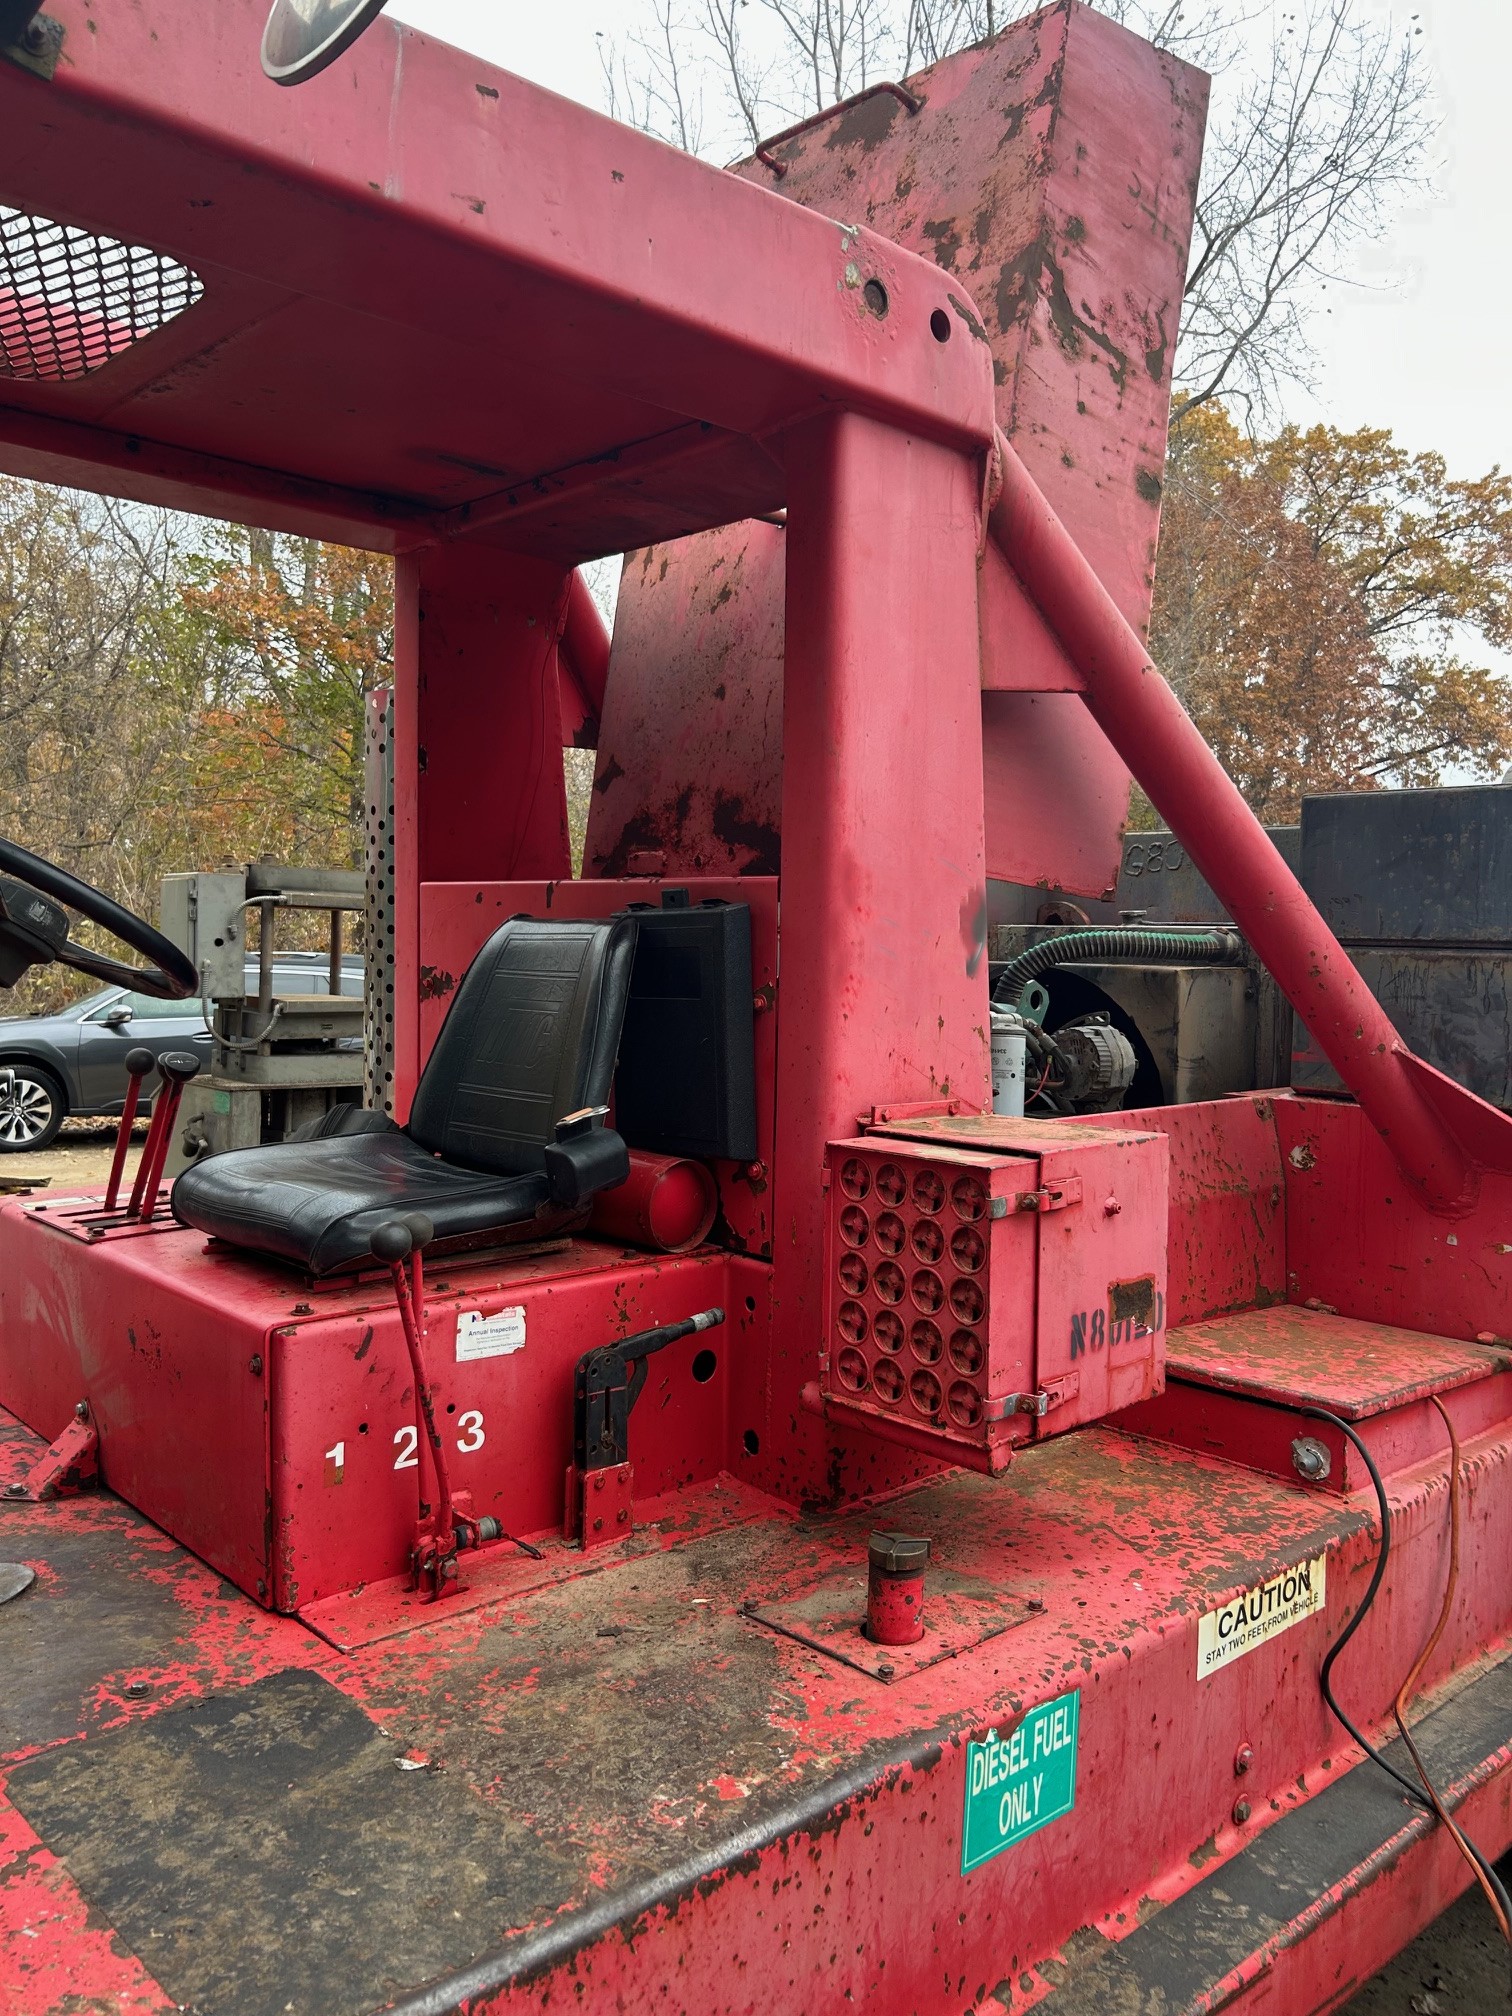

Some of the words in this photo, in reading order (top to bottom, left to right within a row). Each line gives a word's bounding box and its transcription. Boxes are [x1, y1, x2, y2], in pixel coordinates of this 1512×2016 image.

[468, 1328, 489, 1337] Annual
[490, 1325, 519, 1335] Inspection
[325, 1441, 345, 1468] 1
[393, 1425, 419, 1470] 2
[456, 1410, 486, 1453] 3
[1205, 1642, 1227, 1665] STAY
[1228, 1633, 1246, 1653] TWO
[1247, 1622, 1267, 1642] FEET
[1267, 1610, 1288, 1629] FROM
[1289, 1592, 1319, 1617] VEHICLE
[1218, 1569, 1311, 1639] CAUTION
[972, 1728, 1029, 1797] DIESEL
[1033, 1705, 1072, 1763] FUEL
[998, 1772, 1044, 1836] ONLY
